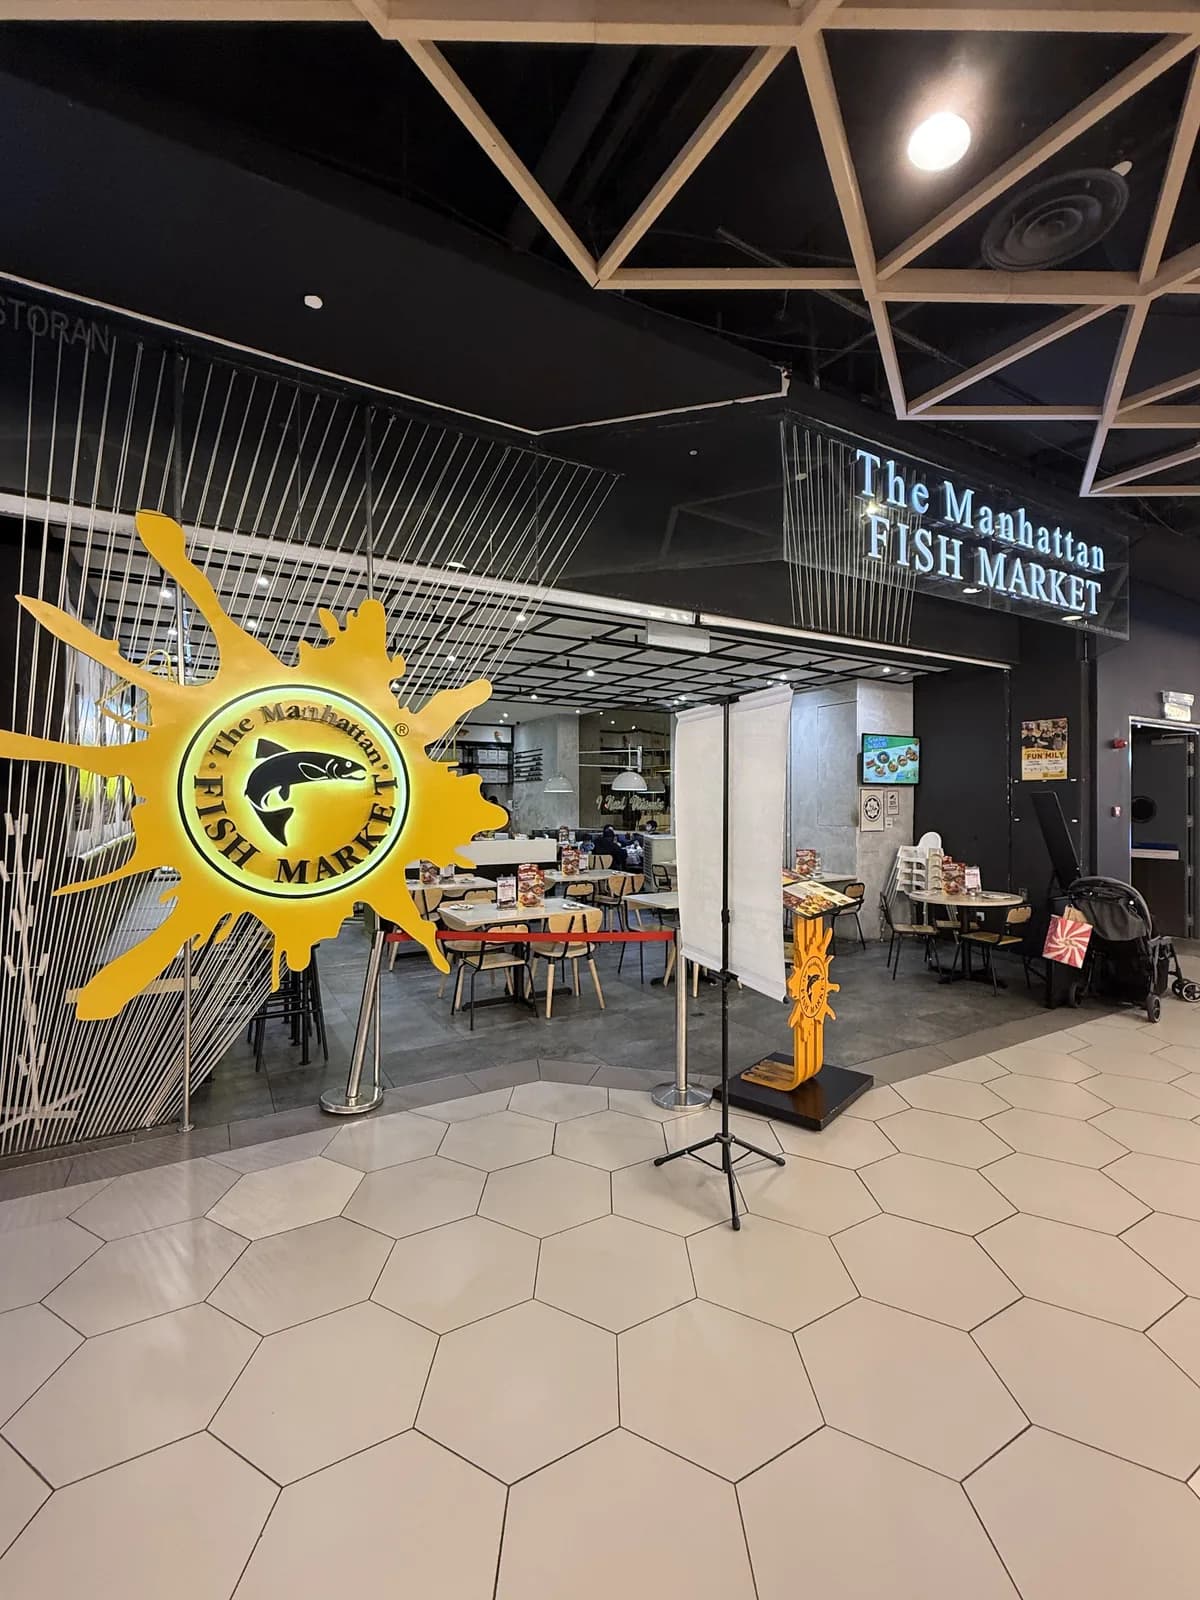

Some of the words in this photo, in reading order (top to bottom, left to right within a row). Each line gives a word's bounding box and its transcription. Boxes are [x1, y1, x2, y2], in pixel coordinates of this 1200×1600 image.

[856, 449, 930, 514] The
[944, 480, 1105, 573] Manhattan
[868, 513, 964, 580] FISH
[978, 546, 1101, 615] MARKET
[209, 717, 255, 758] The
[260, 702, 383, 765] Manhattan
[193, 775, 261, 870] FISH
[273, 774, 398, 884] MARKET
